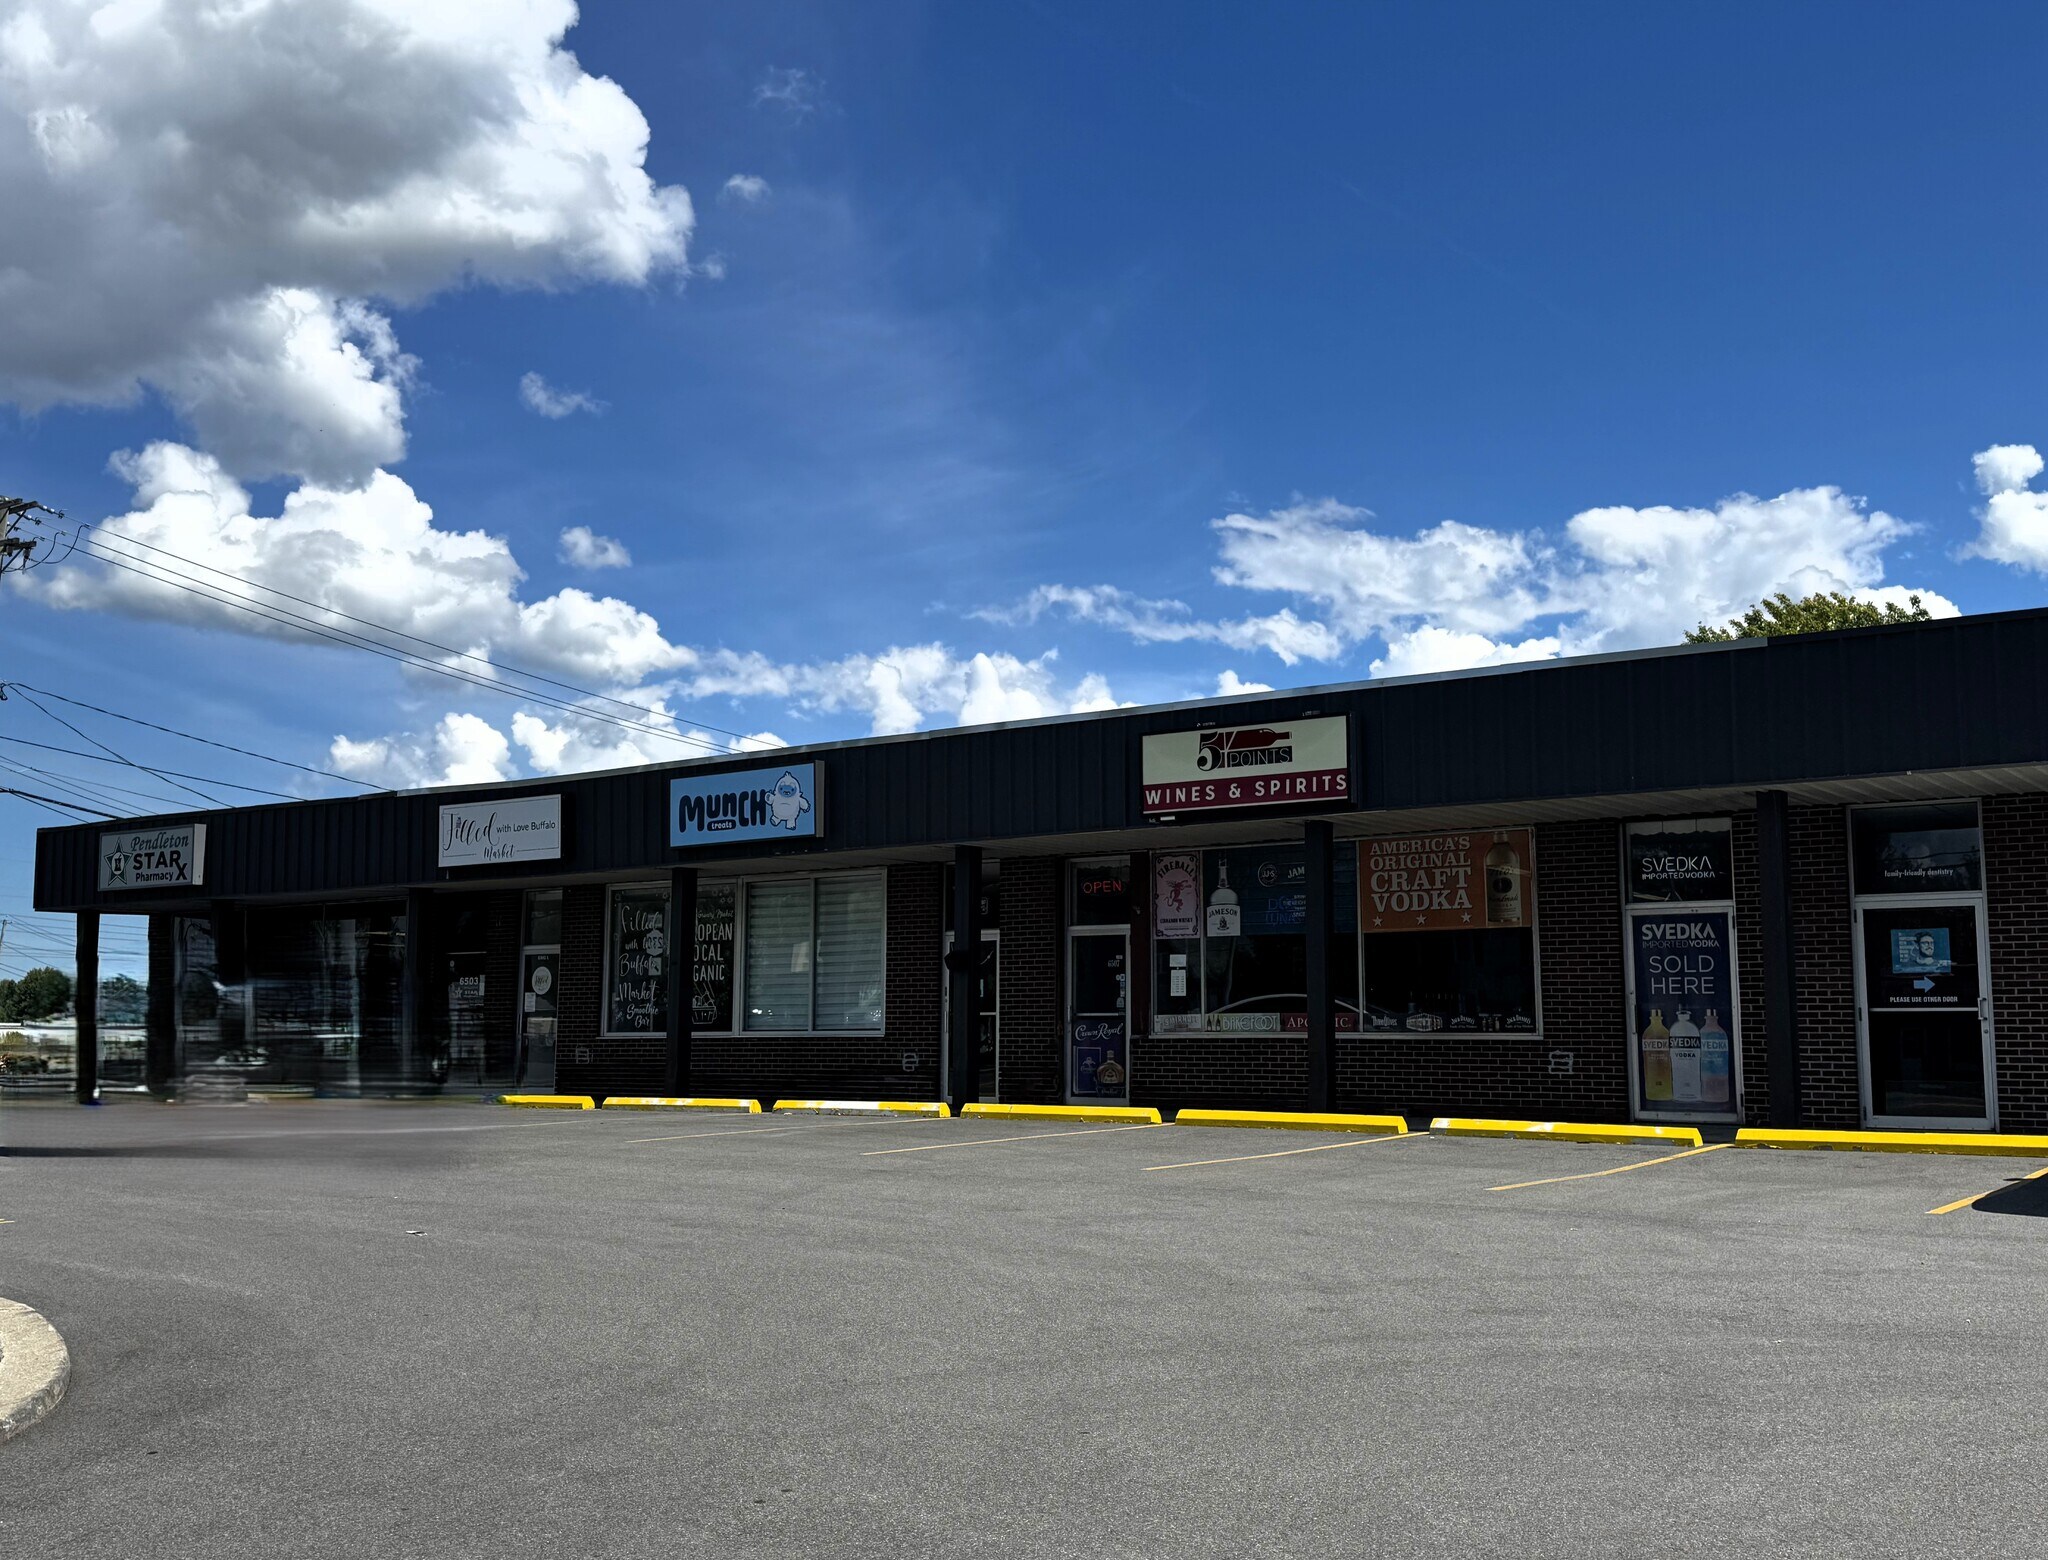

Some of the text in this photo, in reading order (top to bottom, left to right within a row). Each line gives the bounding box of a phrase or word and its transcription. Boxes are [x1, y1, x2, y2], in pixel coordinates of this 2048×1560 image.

[1230, 747, 1290, 767] POINTS
[1146, 774, 1347, 805] WINES & SPIRITS
[497, 823, 511, 833] with
[514, 823, 529, 832] Love
[531, 820, 556, 831] Buffalo
[711, 821, 733, 830] treats
[131, 831, 189, 852] Pendleton
[1370, 836, 1471, 856] AMERICA'S
[1157, 858, 1194, 879] FIREBALL
[1370, 851, 1471, 871] ORIGINAL
[1642, 855, 1713, 873] SVEDKA
[136, 872, 173, 882] Pharmacy
[1287, 866, 1306, 879] JAM
[1371, 867, 1471, 892] CRAFT
[1927, 868, 1954, 877] dentistry
[1083, 880, 1123, 894] OPEN
[1371, 889, 1473, 913] VODKA
[621, 905, 660, 933] Filled
[1208, 907, 1238, 919] JAMESON
[695, 922, 733, 941] OPEAN
[1641, 922, 1716, 941] SVEDKA
[693, 943, 724, 961] OCAL
[693, 964, 725, 982] GANIC
[1649, 955, 1715, 973] SOLD
[459, 976, 479, 985] 6503
[1651, 977, 1715, 994] HERE
[619, 981, 660, 1001] Market
[1889, 995, 1911, 1003] PLEASE
[1911, 995, 1922, 1003] USE
[1942, 995, 1958, 1003] DOOR
[626, 1003, 660, 1020] Smoothie
[1075, 1022, 1124, 1040] Crown Royal
[1223, 1015, 1278, 1030] BAREFOOT
[1644, 1041, 1669, 1049] SVEDK
[1701, 1041, 1727, 1049] VEDKA
